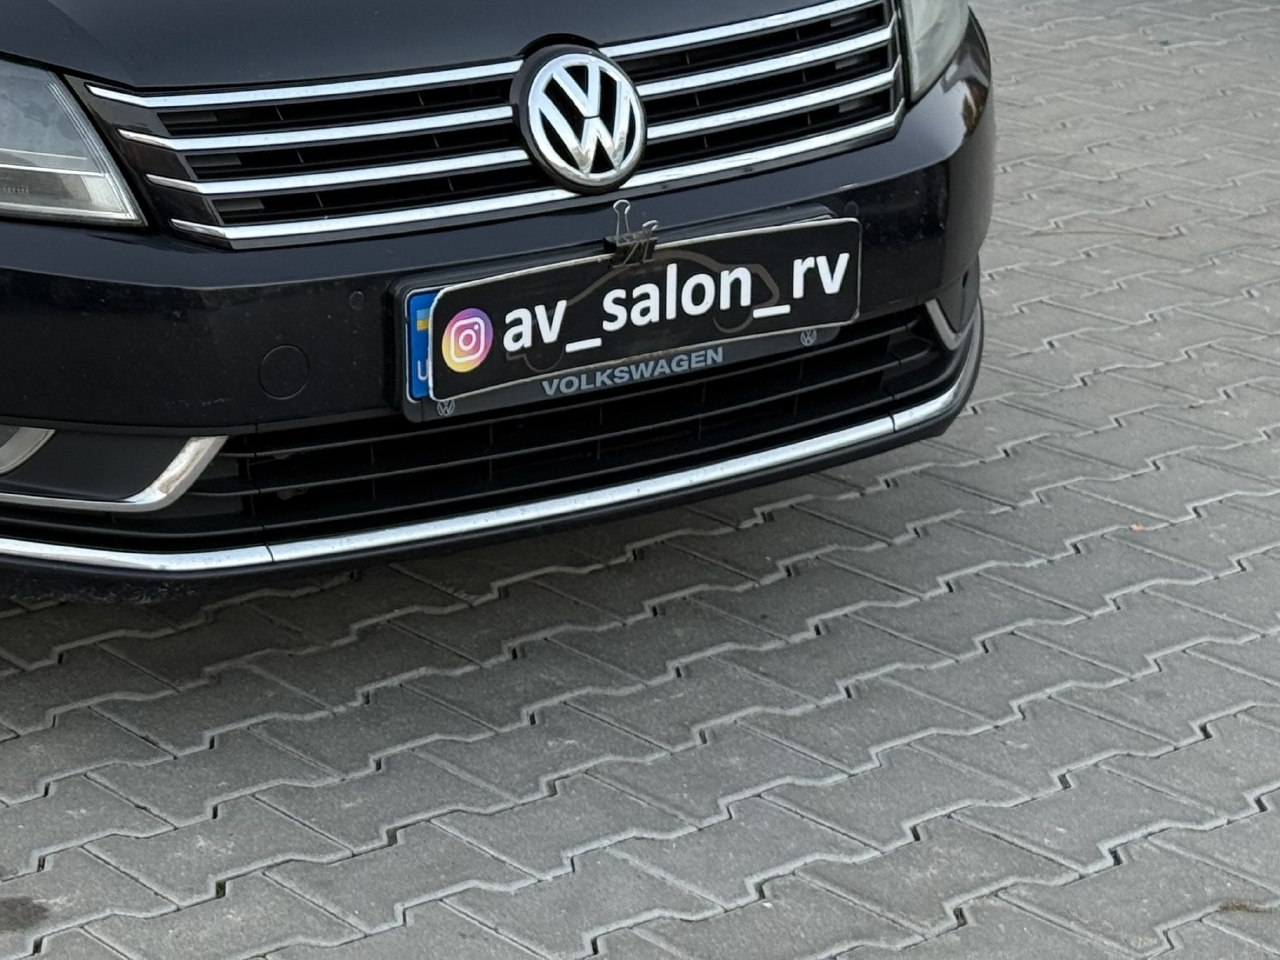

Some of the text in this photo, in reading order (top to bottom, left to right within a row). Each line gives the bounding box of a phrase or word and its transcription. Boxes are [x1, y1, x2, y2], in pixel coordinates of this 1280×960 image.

[528, 53, 643, 187] VW
[502, 252, 850, 353] av_salon_rv
[542, 346, 724, 396] VOLKSWAGEN
